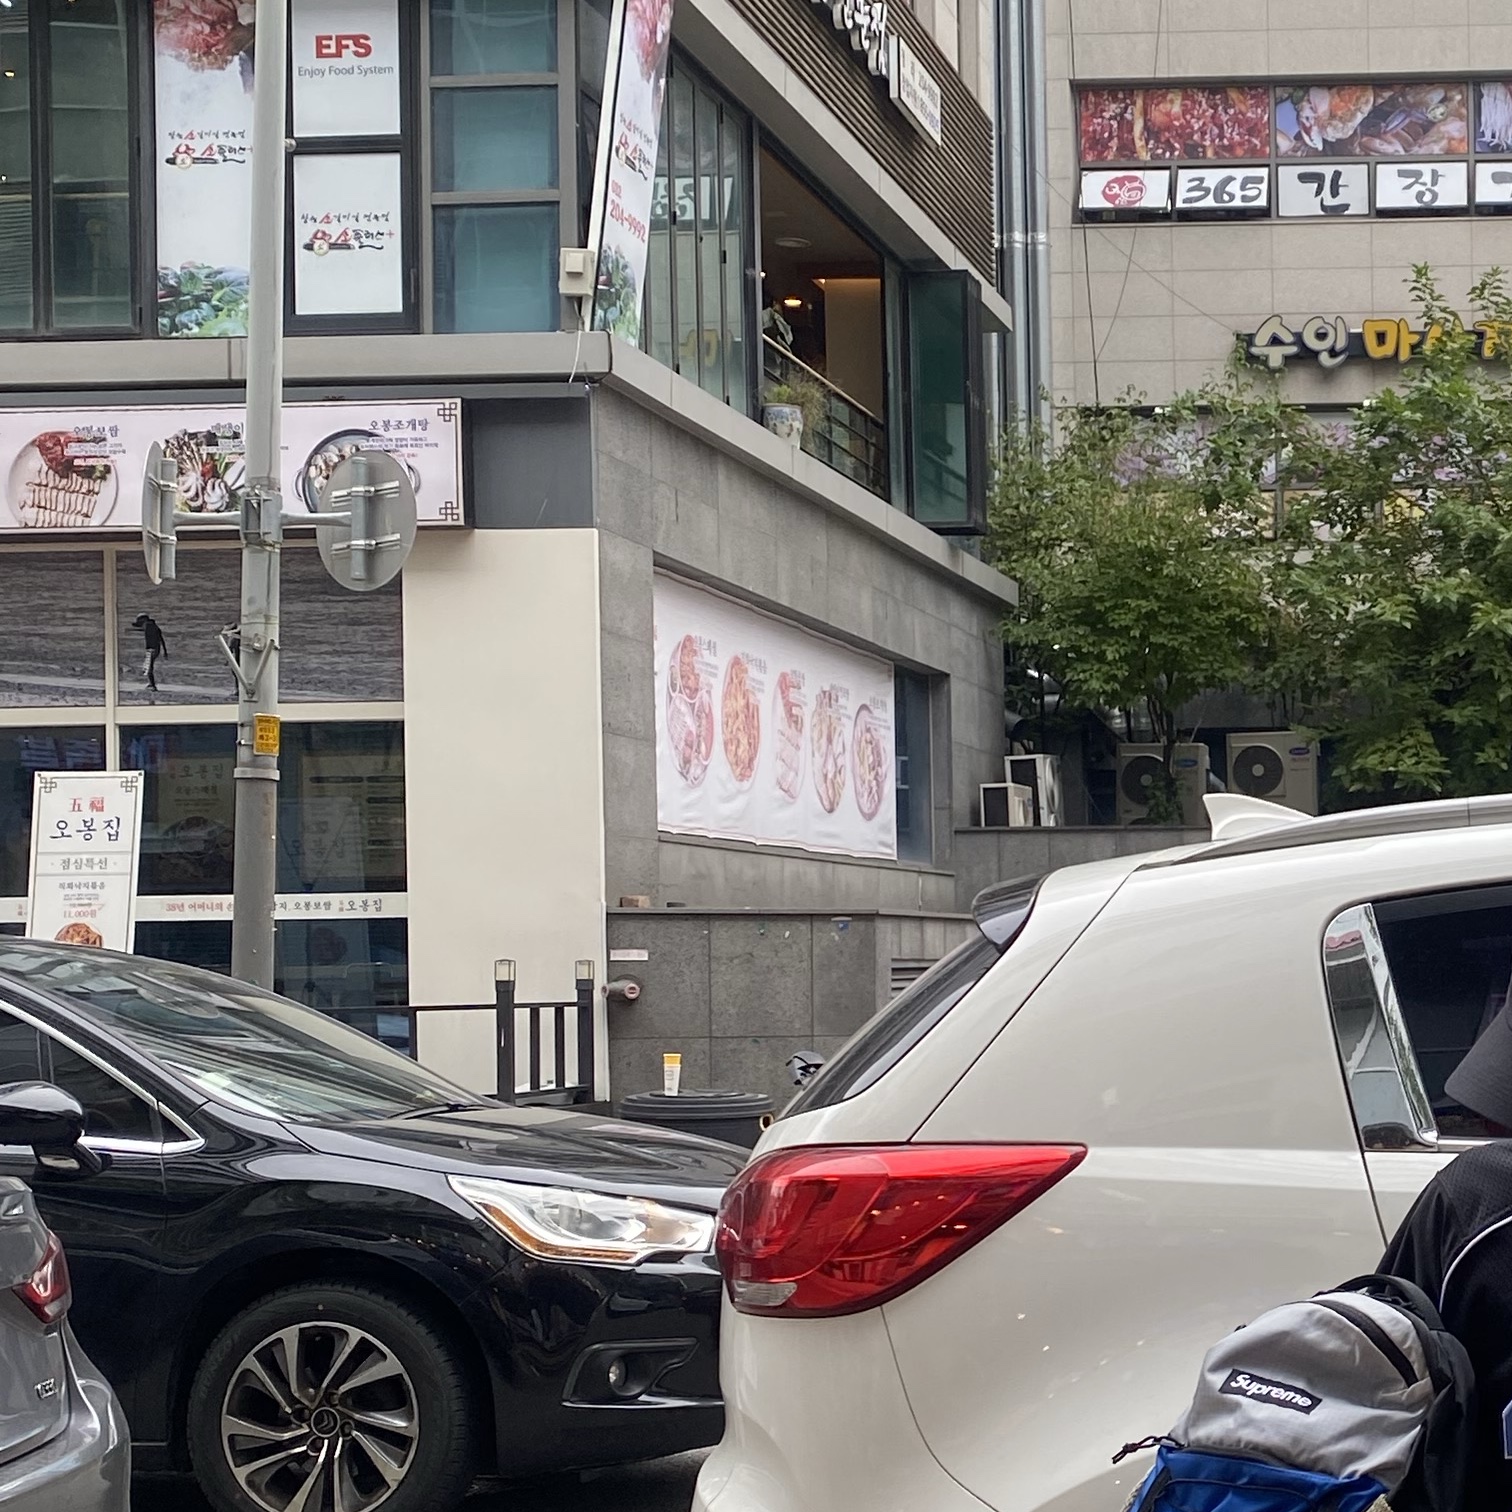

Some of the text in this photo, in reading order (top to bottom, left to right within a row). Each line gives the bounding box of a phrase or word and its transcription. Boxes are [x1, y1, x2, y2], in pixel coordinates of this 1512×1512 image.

[315, 34, 372, 58] EFS
[298, 64, 394, 78] Enjoy Food System
[1182, 175, 1265, 204] 365
[1251, 315, 1349, 369] 수인
[49, 816, 121, 842] 오봉집
[60, 858, 108, 870] 점심특선
[294, 901, 332, 911] 오봉보쌈
[345, 898, 382, 912] 오봉집
[1230, 1372, 1312, 1408] Supreme
